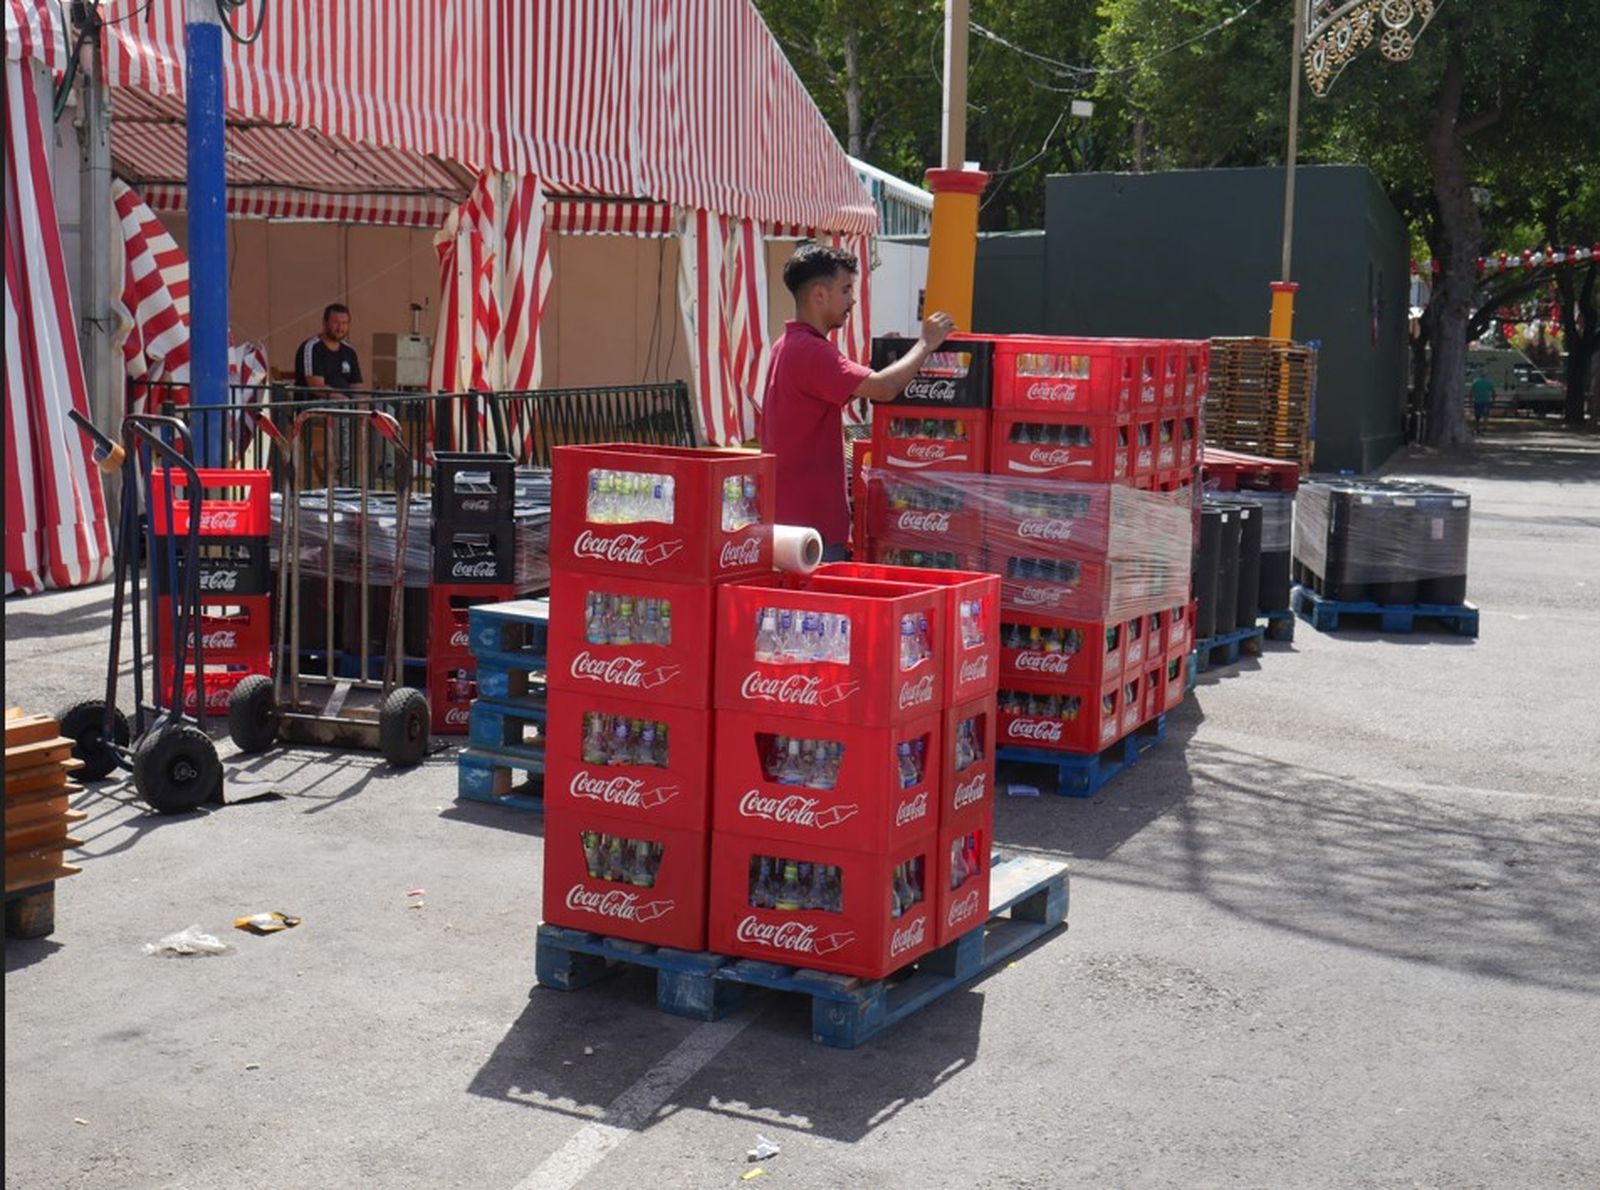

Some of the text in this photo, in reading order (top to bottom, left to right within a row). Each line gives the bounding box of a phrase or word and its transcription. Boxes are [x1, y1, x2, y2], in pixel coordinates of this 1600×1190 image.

[574, 530, 648, 563] Coca-Cola
[570, 651, 646, 687] Coca-Cola
[741, 671, 822, 705] Coca-Cola
[570, 771, 645, 807] Coca-Cola
[739, 790, 819, 827] Coca-Cola
[566, 884, 639, 920] Coca-Cola
[737, 915, 816, 952] Coca-Cola
